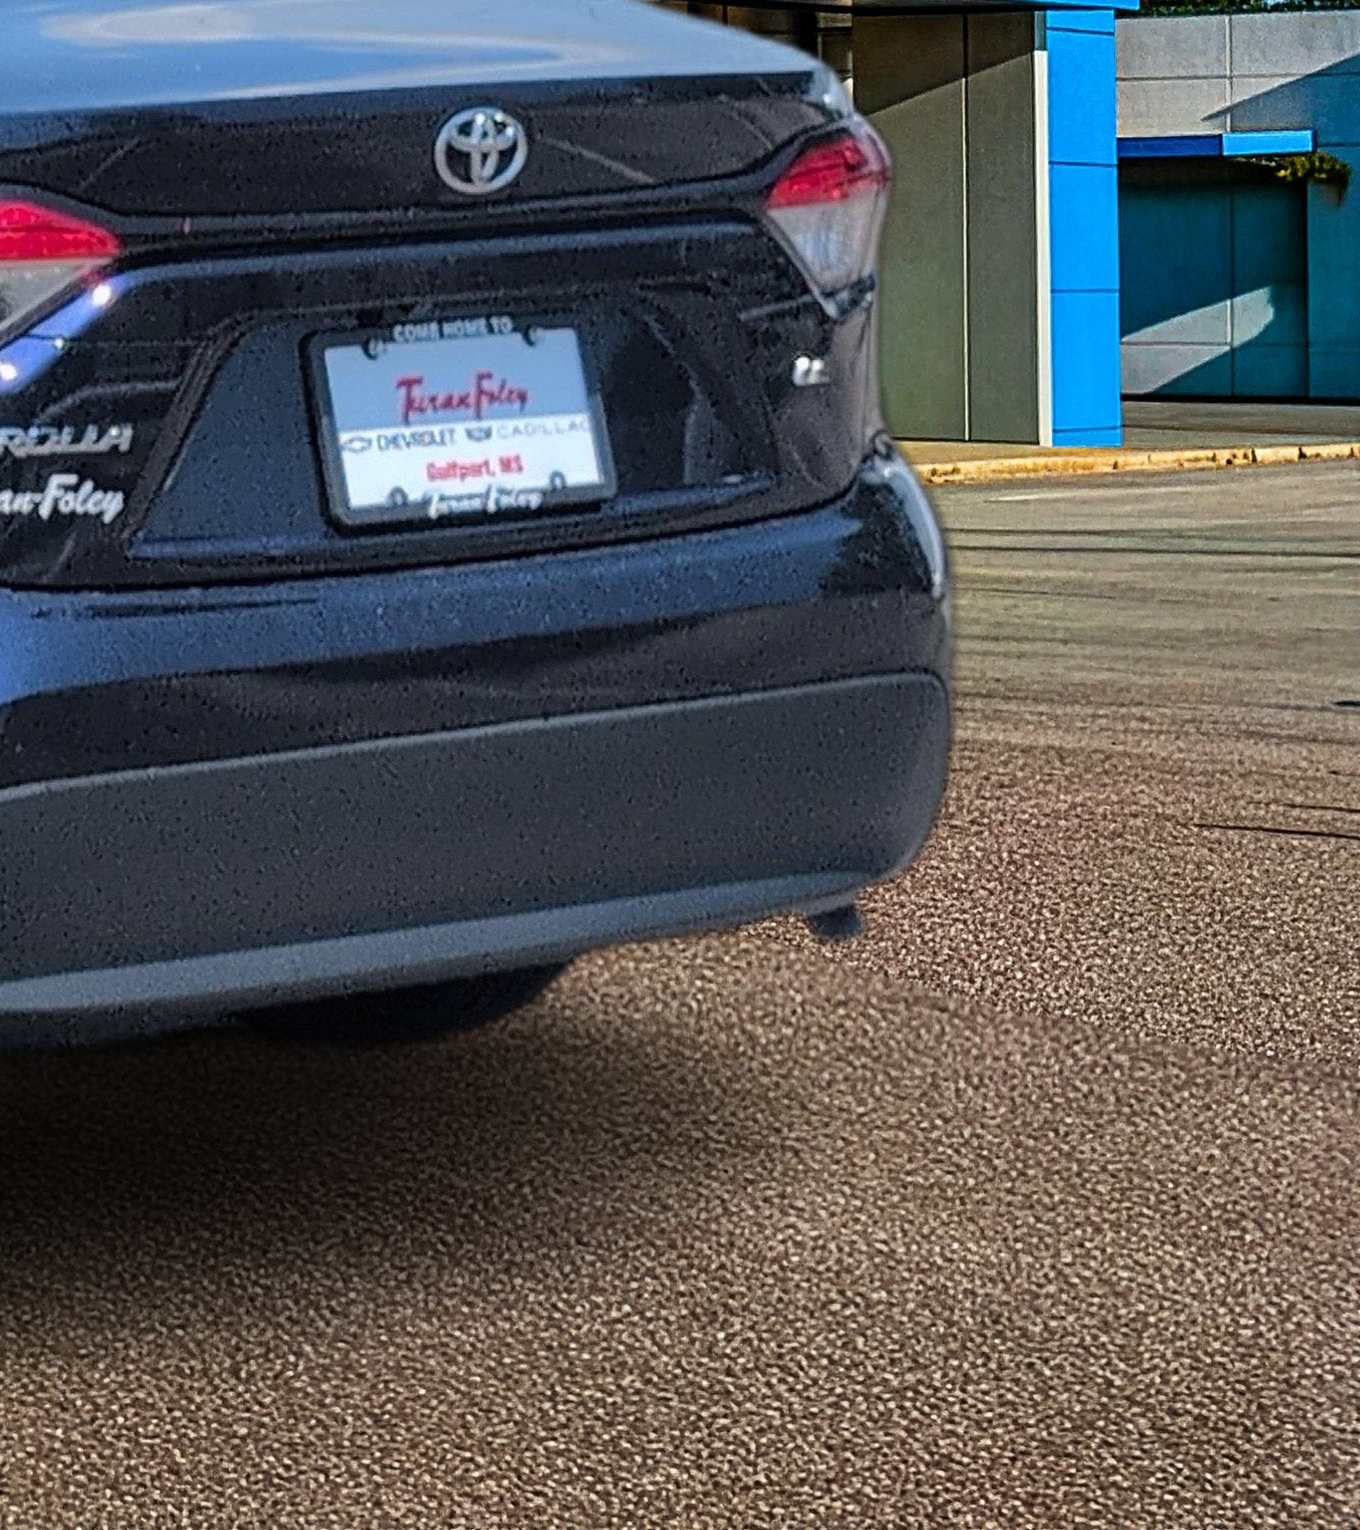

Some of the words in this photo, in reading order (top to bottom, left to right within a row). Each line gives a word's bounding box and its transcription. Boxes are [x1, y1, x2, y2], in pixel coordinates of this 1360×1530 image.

[489, 315, 514, 335] TO
[376, 427, 457, 451] CHEVROLET
[495, 419, 590, 441] CADILLAC
[498, 452, 524, 475] MS
